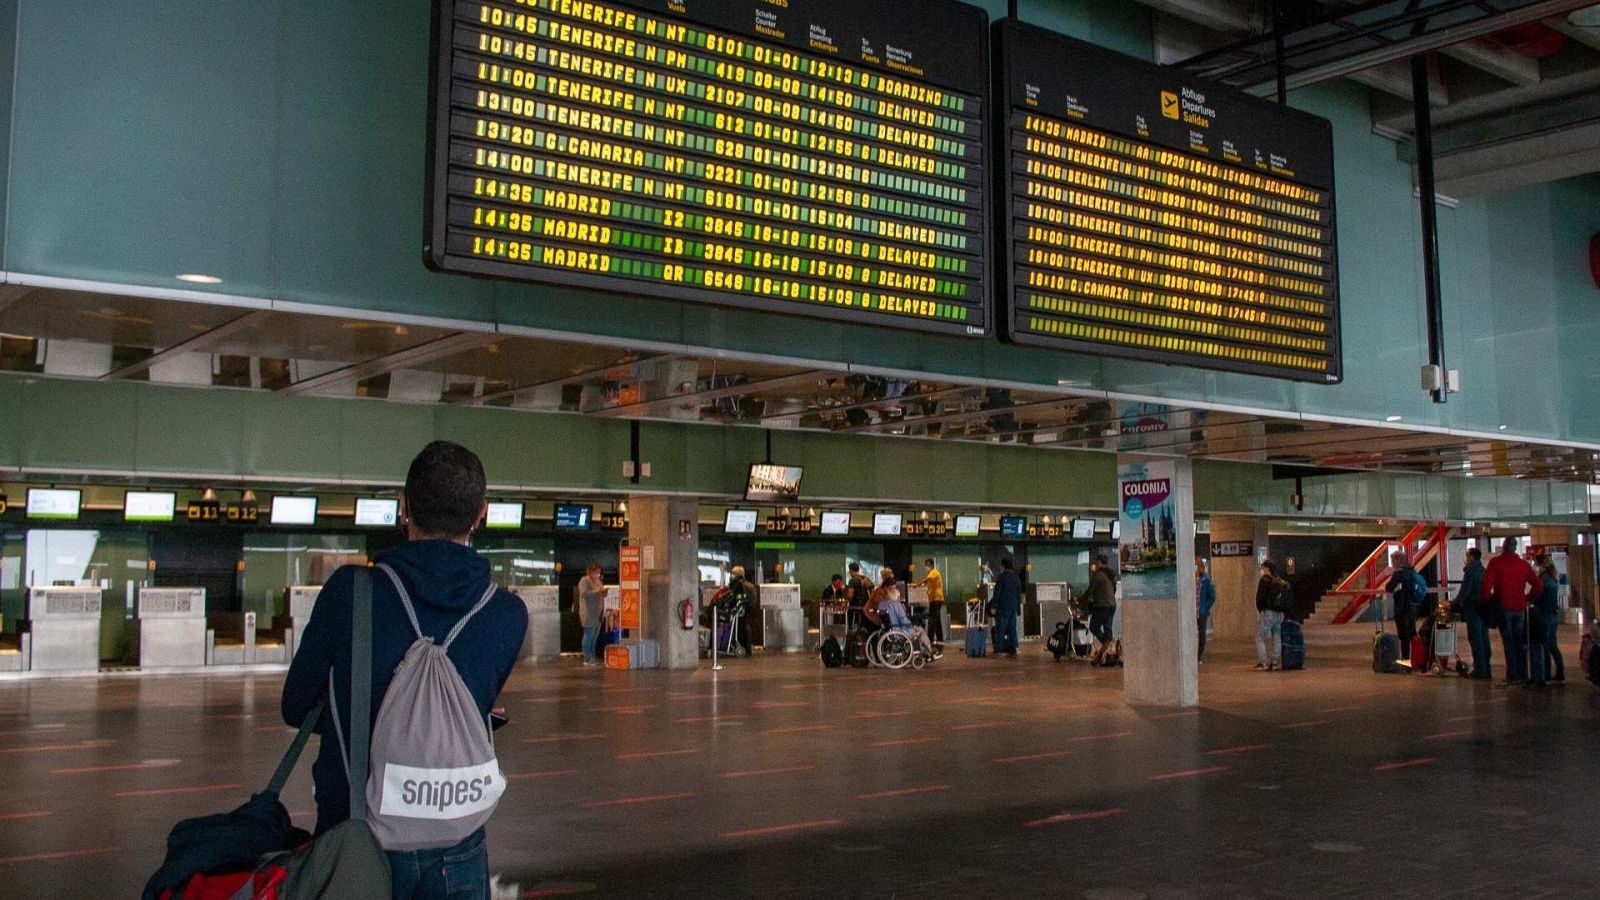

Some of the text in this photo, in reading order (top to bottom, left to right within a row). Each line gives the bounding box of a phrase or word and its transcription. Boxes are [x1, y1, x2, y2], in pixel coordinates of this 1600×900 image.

[481, 6, 936, 126] 10:45 TENERIFE N PM 419 08-08 14:50 DELAYED
[551, 0, 941, 105] TENERIFE N NT 6101 01-01 12:13 9 BOARDING
[479, 63, 535, 89] 11:00
[549, 77, 634, 110] TENERIFE
[645, 98, 655, 114] N
[666, 103, 684, 120] NT
[716, 113, 744, 133] 612
[754, 122, 798, 144] 01-01
[862, 145, 869, 159] 6
[879, 149, 934, 173] DELAYED
[480, 34, 536, 61] 10:45
[549, 49, 634, 83] TENERIFE
[646, 72, 655, 87] N
[666, 76, 686, 94] UX
[706, 85, 744, 106] 2107
[810, 109, 852, 131] 14:50
[878, 125, 936, 150] DELAYED
[1181, 98, 1216, 118] Departures
[1183, 110, 1209, 128] Salidas
[477, 91, 534, 116] 13:00
[547, 105, 633, 136] TENERIFE
[645, 125, 654, 140] N
[665, 129, 684, 146] NT
[716, 139, 743, 158] 628
[754, 147, 799, 169] 01-01
[862, 169, 869, 183] 6
[477, 120, 869, 208] 13:20 G.CANARIA NT 3221 01-01 12:58 9
[1026, 117, 1060, 136] 14:35
[1067, 128, 1105, 148] MADRID
[1223, 169, 1251, 185] 15:09
[1265, 180, 1301, 198] DELAYED
[476, 149, 935, 244] 14:00 TENERIFE N NT 6181 01-01 15:04 DELAYED
[1027, 138, 1060, 157] 16:00
[1068, 148, 1119, 172] TENERIFE
[1125, 163, 1131, 174] N
[1138, 166, 1149, 179] NT
[1191, 179, 1218, 196] 01-01
[1224, 188, 1250, 204] 15:42
[1027, 160, 1061, 179] 16:05
[1068, 170, 1107, 190] BERLIN
[1190, 199, 1219, 216] 10-12
[1225, 208, 1251, 223] 15:30
[475, 178, 532, 202] 14:35
[544, 190, 610, 215] MADRID
[754, 225, 799, 246] 16-18
[810, 234, 852, 254] 15:09
[879, 246, 935, 268] DELAYED
[1069, 191, 1120, 214] TENERIFE
[1127, 204, 1133, 216] N
[1139, 207, 1150, 220] NT
[1192, 219, 1219, 235] 01-01
[1070, 213, 1121, 235] TENERIFE
[1127, 225, 1133, 237] N
[1140, 228, 1153, 241] NT
[1193, 239, 1220, 255] 01-01
[1227, 247, 1253, 262] 17:42
[474, 208, 532, 231] 14:35
[544, 219, 610, 244] MADRID
[754, 251, 799, 272] 16-18
[810, 260, 853, 280] 15:09
[879, 271, 935, 292] DELAYED
[474, 237, 531, 260] 14:35
[544, 247, 609, 271] MADRID
[754, 277, 799, 297] 16-18
[810, 285, 853, 305] 15:09
[879, 295, 935, 316] DELAYED
[1070, 235, 1121, 256] TENERIFE
[1128, 247, 1134, 259] N
[1140, 249, 1152, 262] PM
[1227, 267, 1255, 282] 17:42
[1071, 257, 1122, 278] TENERIFE
[1128, 268, 1136, 280] N
[1141, 270, 1154, 283] UX
[1228, 287, 1256, 302] 17:42
[1071, 279, 1129, 300] G.CANARIA
[1142, 292, 1155, 304] NT
[1195, 300, 1222, 316] 01-01
[1229, 307, 1257, 321] 17:45
[203, 506, 218, 519] 11
[242, 507, 258, 519] 12
[1124, 481, 1168, 496] COLONIA
[613, 517, 625, 528] 15
[777, 520, 787, 530] 17
[402, 777, 484, 813] snipes
